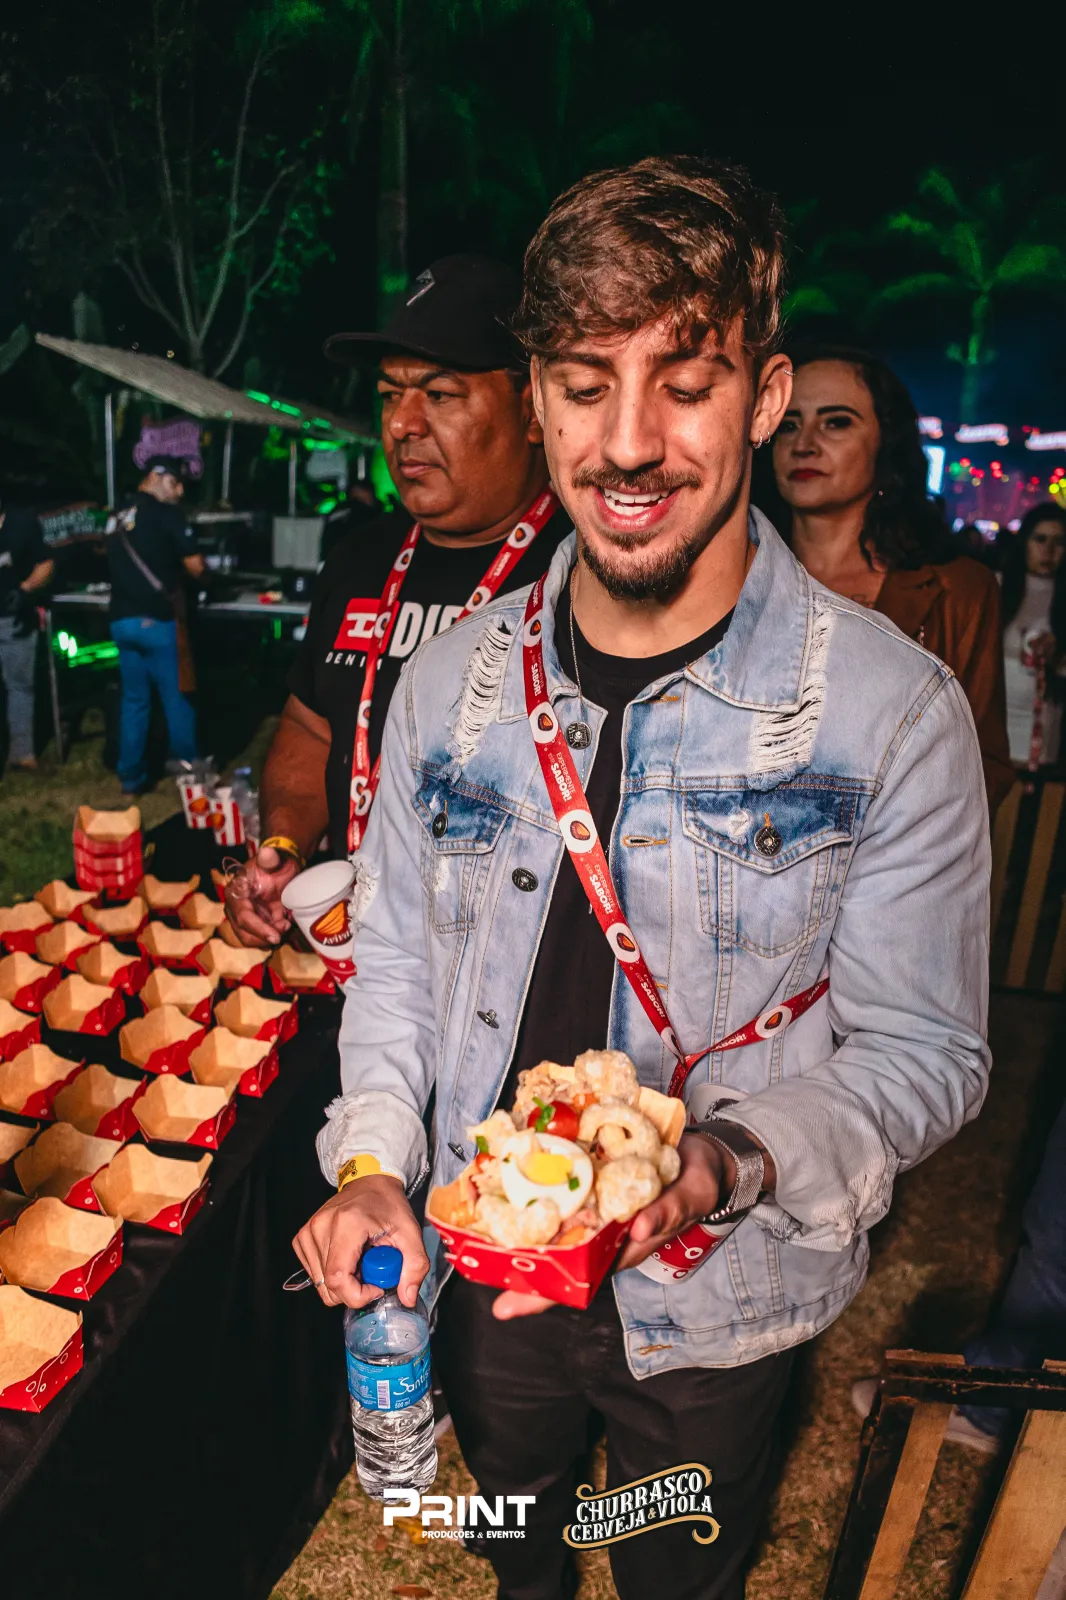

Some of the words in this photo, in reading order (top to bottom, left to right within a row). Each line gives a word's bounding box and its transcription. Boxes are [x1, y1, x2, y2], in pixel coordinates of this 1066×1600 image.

[550, 762, 573, 802] SABOR!
[589, 873, 614, 915] SABOR!
[640, 981, 666, 1018] SABOR!
